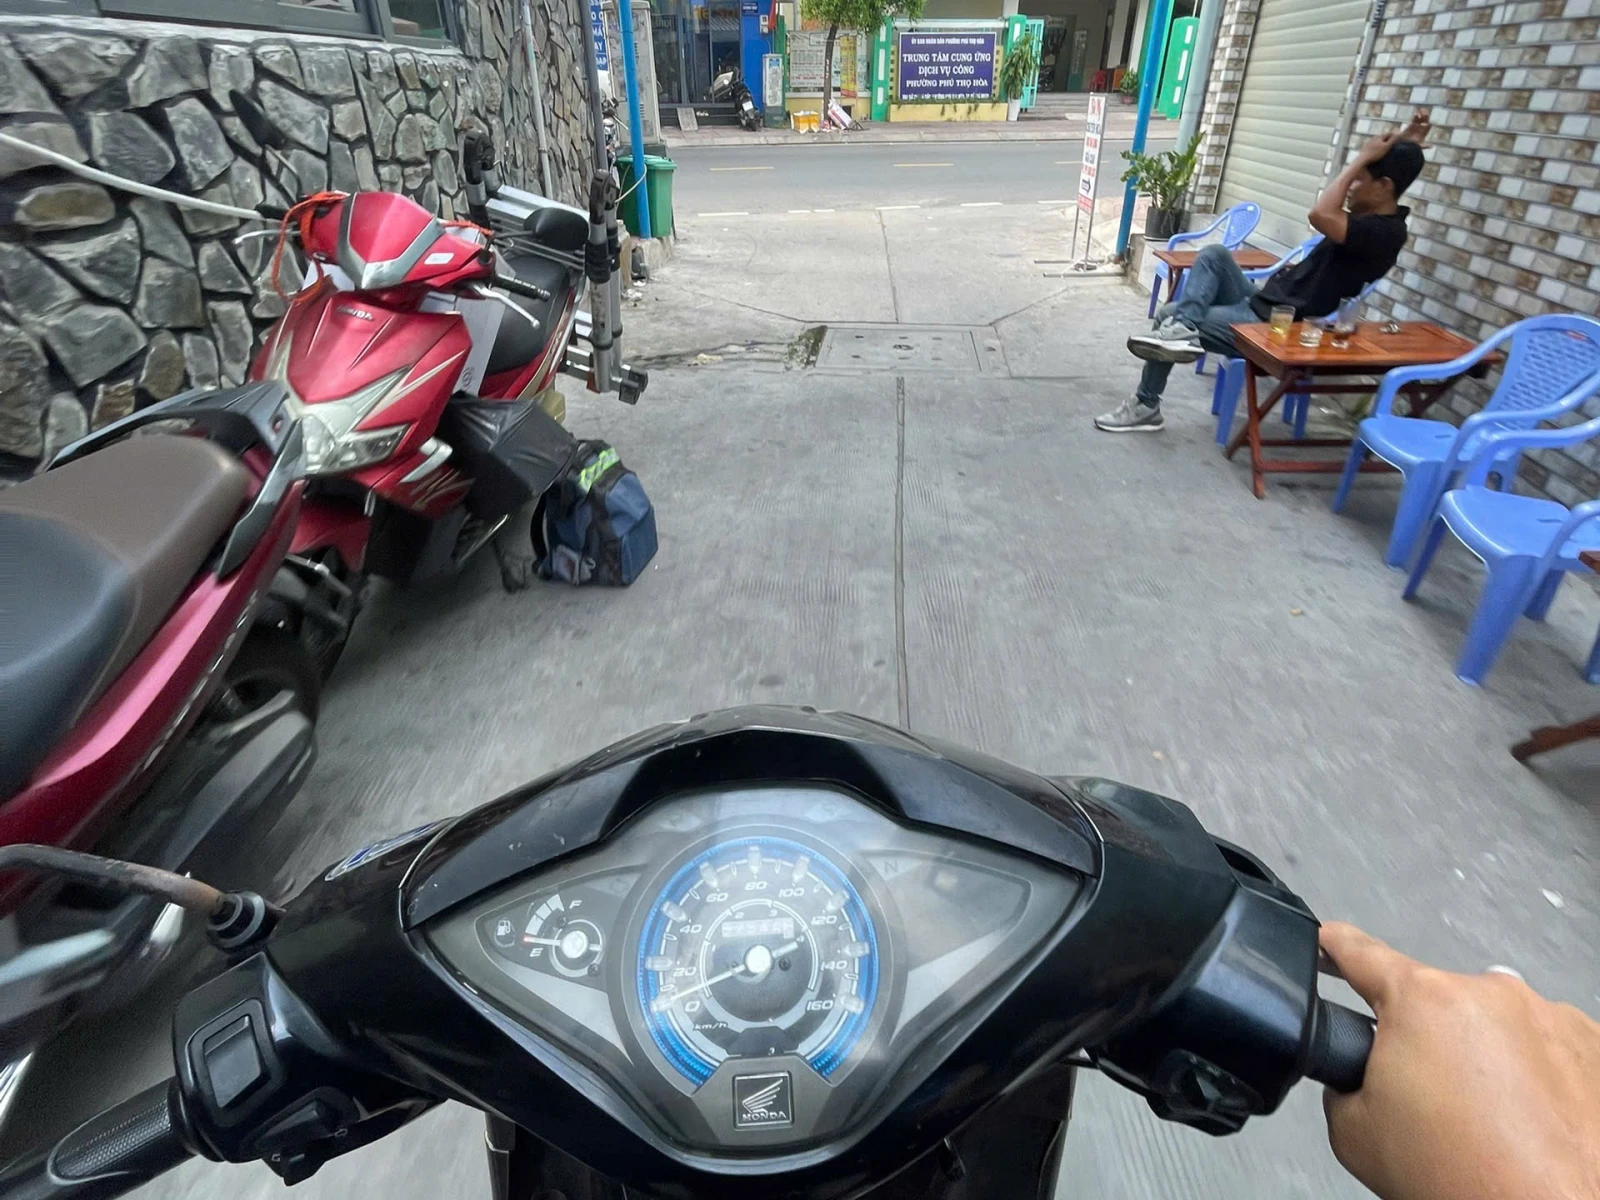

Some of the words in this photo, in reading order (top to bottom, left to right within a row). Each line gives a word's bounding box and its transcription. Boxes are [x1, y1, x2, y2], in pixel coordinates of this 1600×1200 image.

[902, 53, 930, 62] TRUNG
[932, 52, 949, 62] TÂM
[951, 53, 972, 62] CUNG
[974, 51, 991, 61] ỨNG
[918, 65, 938, 77] DỊCH
[940, 65, 951, 77] VỤ
[952, 64, 974, 75] CÔNG
[906, 78, 937, 87] PHƯỜNG
[939, 78, 954, 87] PHÚ
[956, 79, 972, 88] THỌ
[973, 78, 988, 87] HÒA
[744, 881, 767, 891] 80
[778, 888, 804, 897] 100
[706, 893, 728, 903] 60
[569, 900, 582, 909] F
[811, 915, 837, 925] 120
[679, 924, 702, 934] 40
[529, 947, 543, 957] E
[821, 960, 848, 970] 140
[673, 967, 697, 977] 20
[684, 1001, 700, 1012] 0
[806, 1000, 834, 1011] 160
[693, 1022, 728, 1031] km/h
[742, 1111, 787, 1121] HONDA
